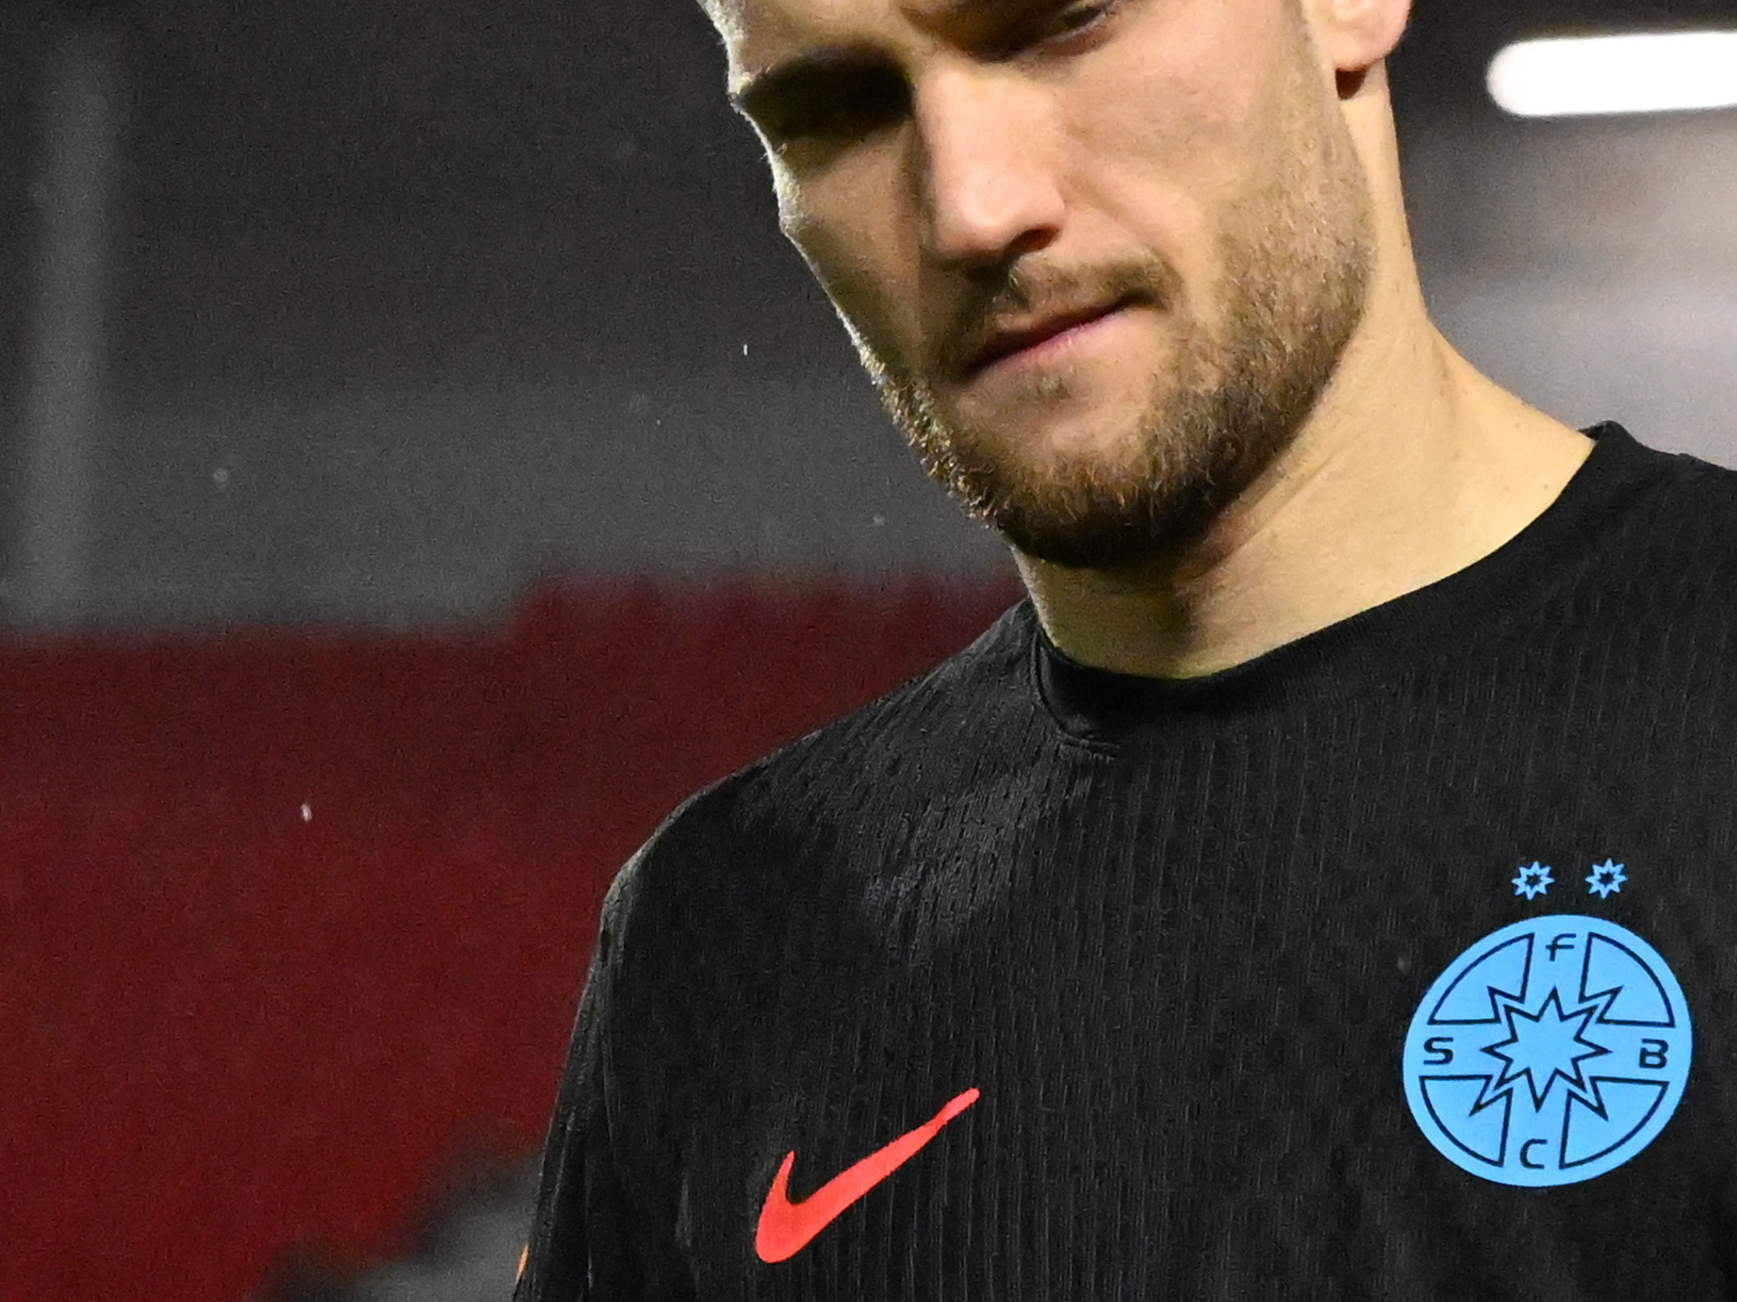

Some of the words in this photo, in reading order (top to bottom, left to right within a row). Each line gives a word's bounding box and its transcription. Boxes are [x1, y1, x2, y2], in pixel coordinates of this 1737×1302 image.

[1422, 1036, 1454, 1066] S
[1638, 1038, 1670, 1070] B
[1518, 1138, 1548, 1170] C
